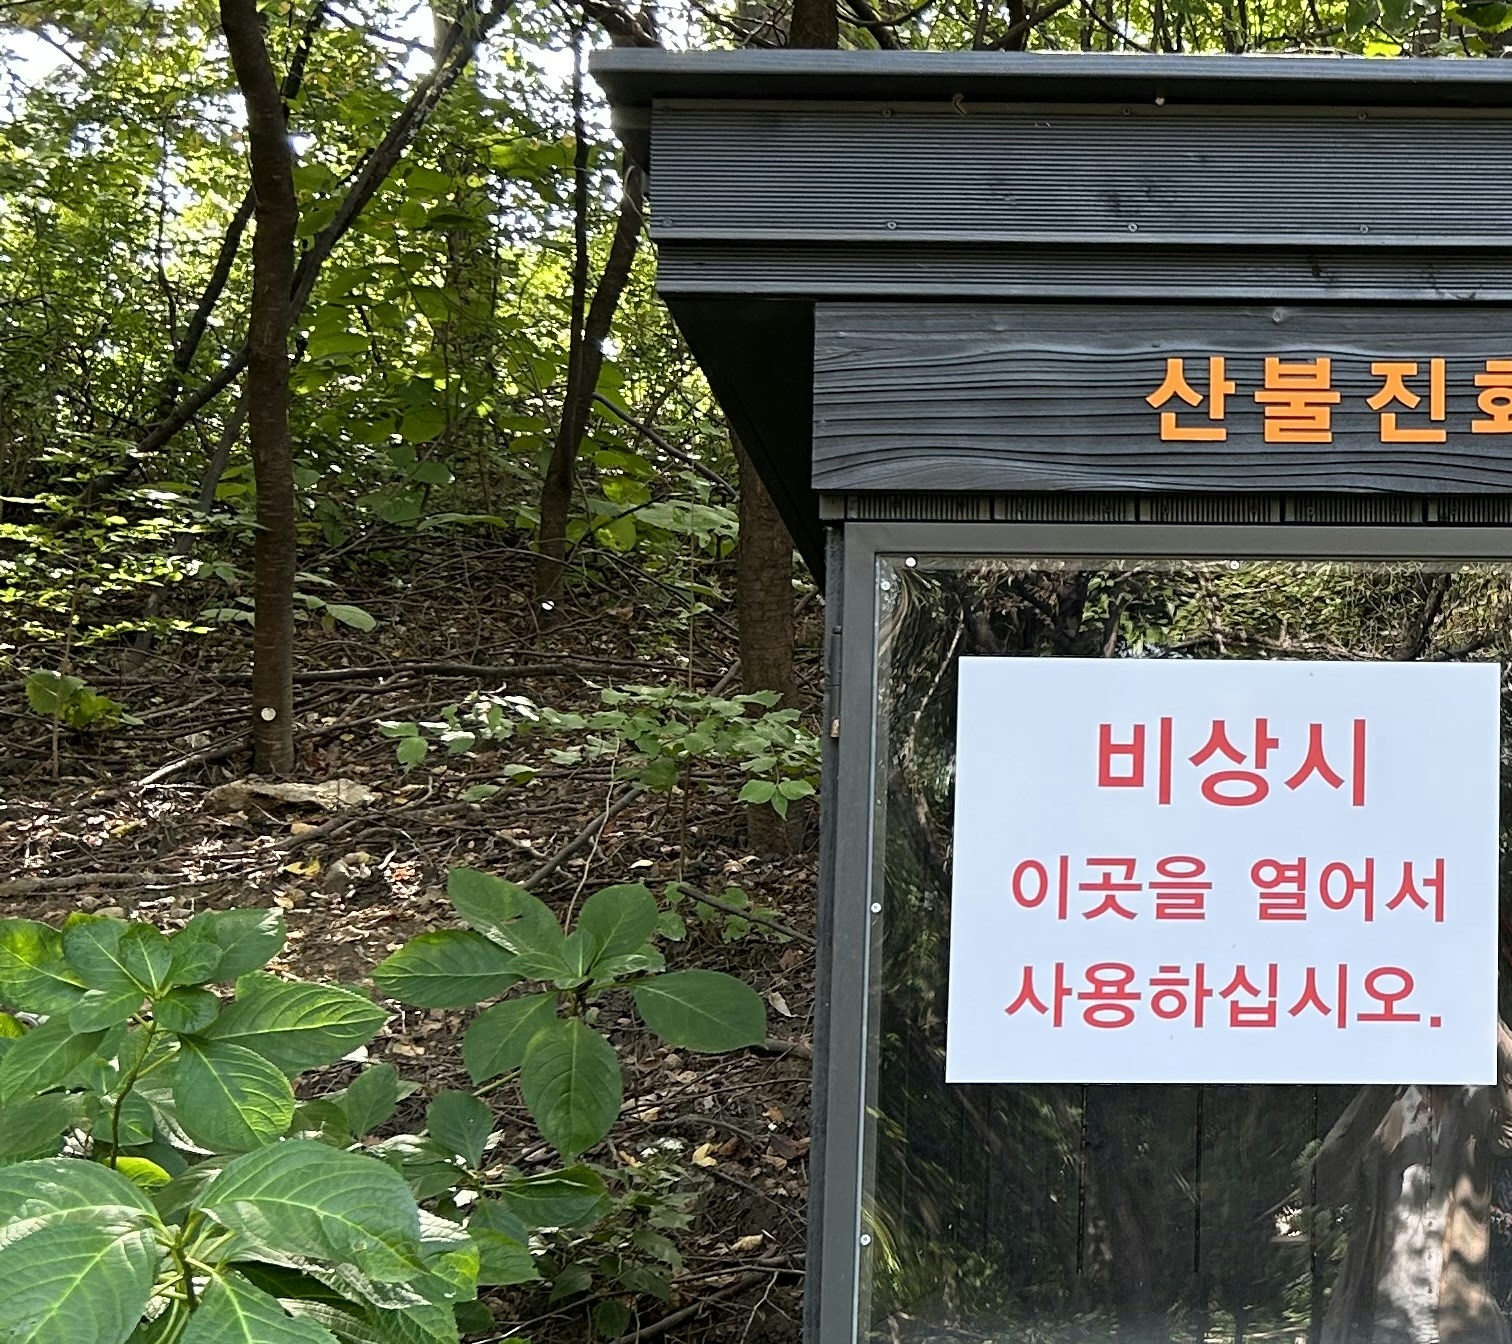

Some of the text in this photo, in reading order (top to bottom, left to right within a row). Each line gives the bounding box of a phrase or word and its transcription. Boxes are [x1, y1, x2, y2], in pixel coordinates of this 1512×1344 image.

[1098, 716, 1366, 807] 비상시
[1011, 855, 1445, 922] 이곳을 열어서
[1006, 961, 1442, 1029] 사용하십시오.
